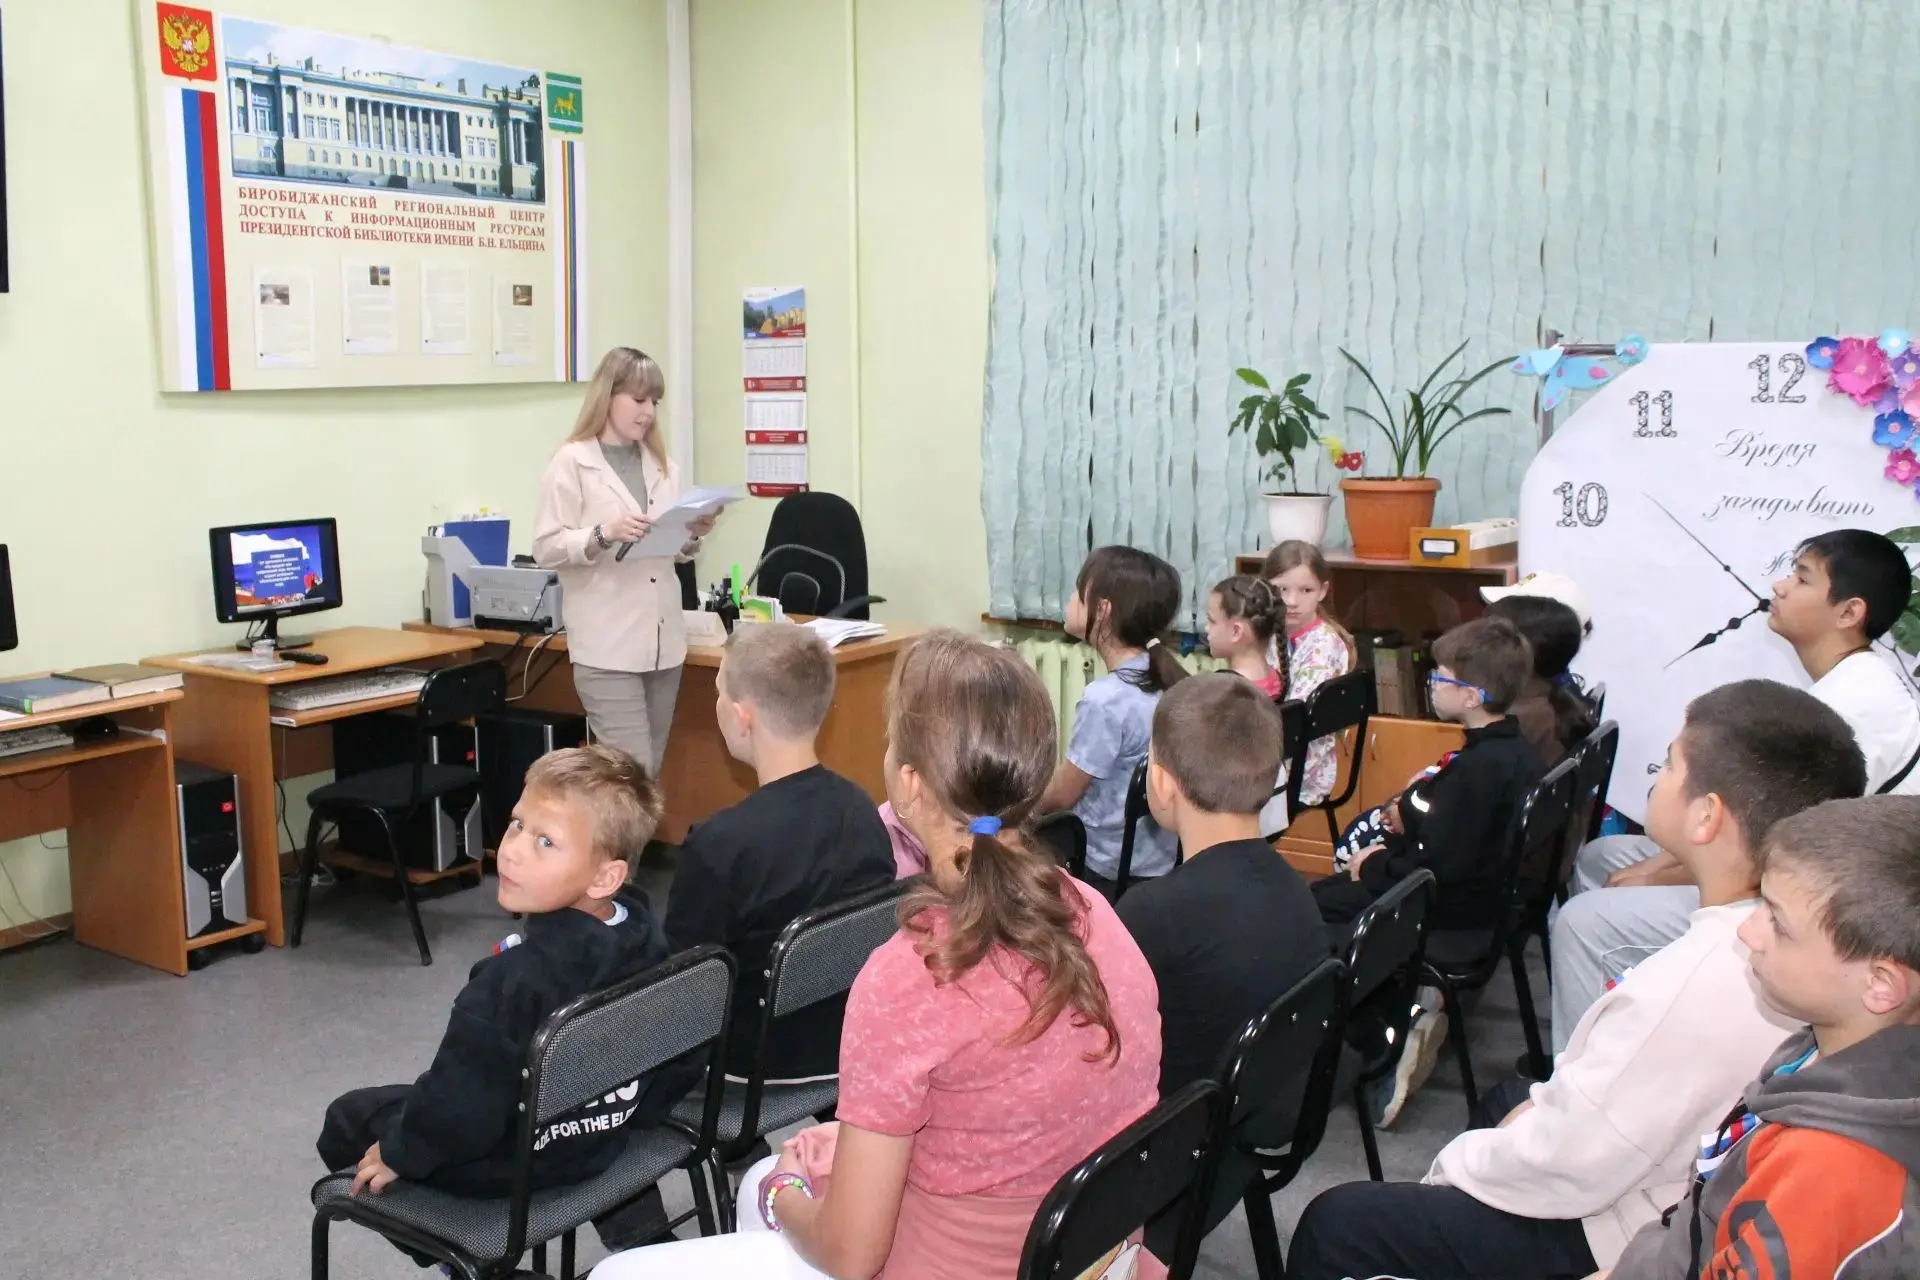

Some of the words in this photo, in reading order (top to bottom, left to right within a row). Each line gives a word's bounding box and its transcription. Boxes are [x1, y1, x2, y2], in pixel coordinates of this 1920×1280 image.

[239, 187, 377, 209] БИРОБИДЖАНСКИЙ
[395, 200, 495, 219] РЕГИОНАЛЬНЫЙ
[510, 210, 545, 223] ЦЕНТР
[239, 204, 307, 220] ДОСТУПА
[324, 211, 333, 222] К
[350, 212, 476, 233] ИНФОРМАЦИОННЫМ
[490, 223, 545, 237] РЕСУРСАМ
[240, 221, 351, 240] ПРЕЗИДЕНТСКОЙ
[354, 229, 432, 244] БИБЛИОТЕКИ
[434, 233, 474, 247] ИМЕНИ
[478, 237, 496, 248] Б.Н.
[499, 238, 546, 251] ЕЛЬЦИНА
[1748, 353, 1808, 404] 12
[1628, 390, 1678, 439] 11
[1714, 428, 1818, 468] Время
[1553, 481, 1609, 528] 10
[1702, 484, 1876, 521] загадывать
[550, 1120, 581, 1140] FOR
[580, 1114, 609, 1133] THE
